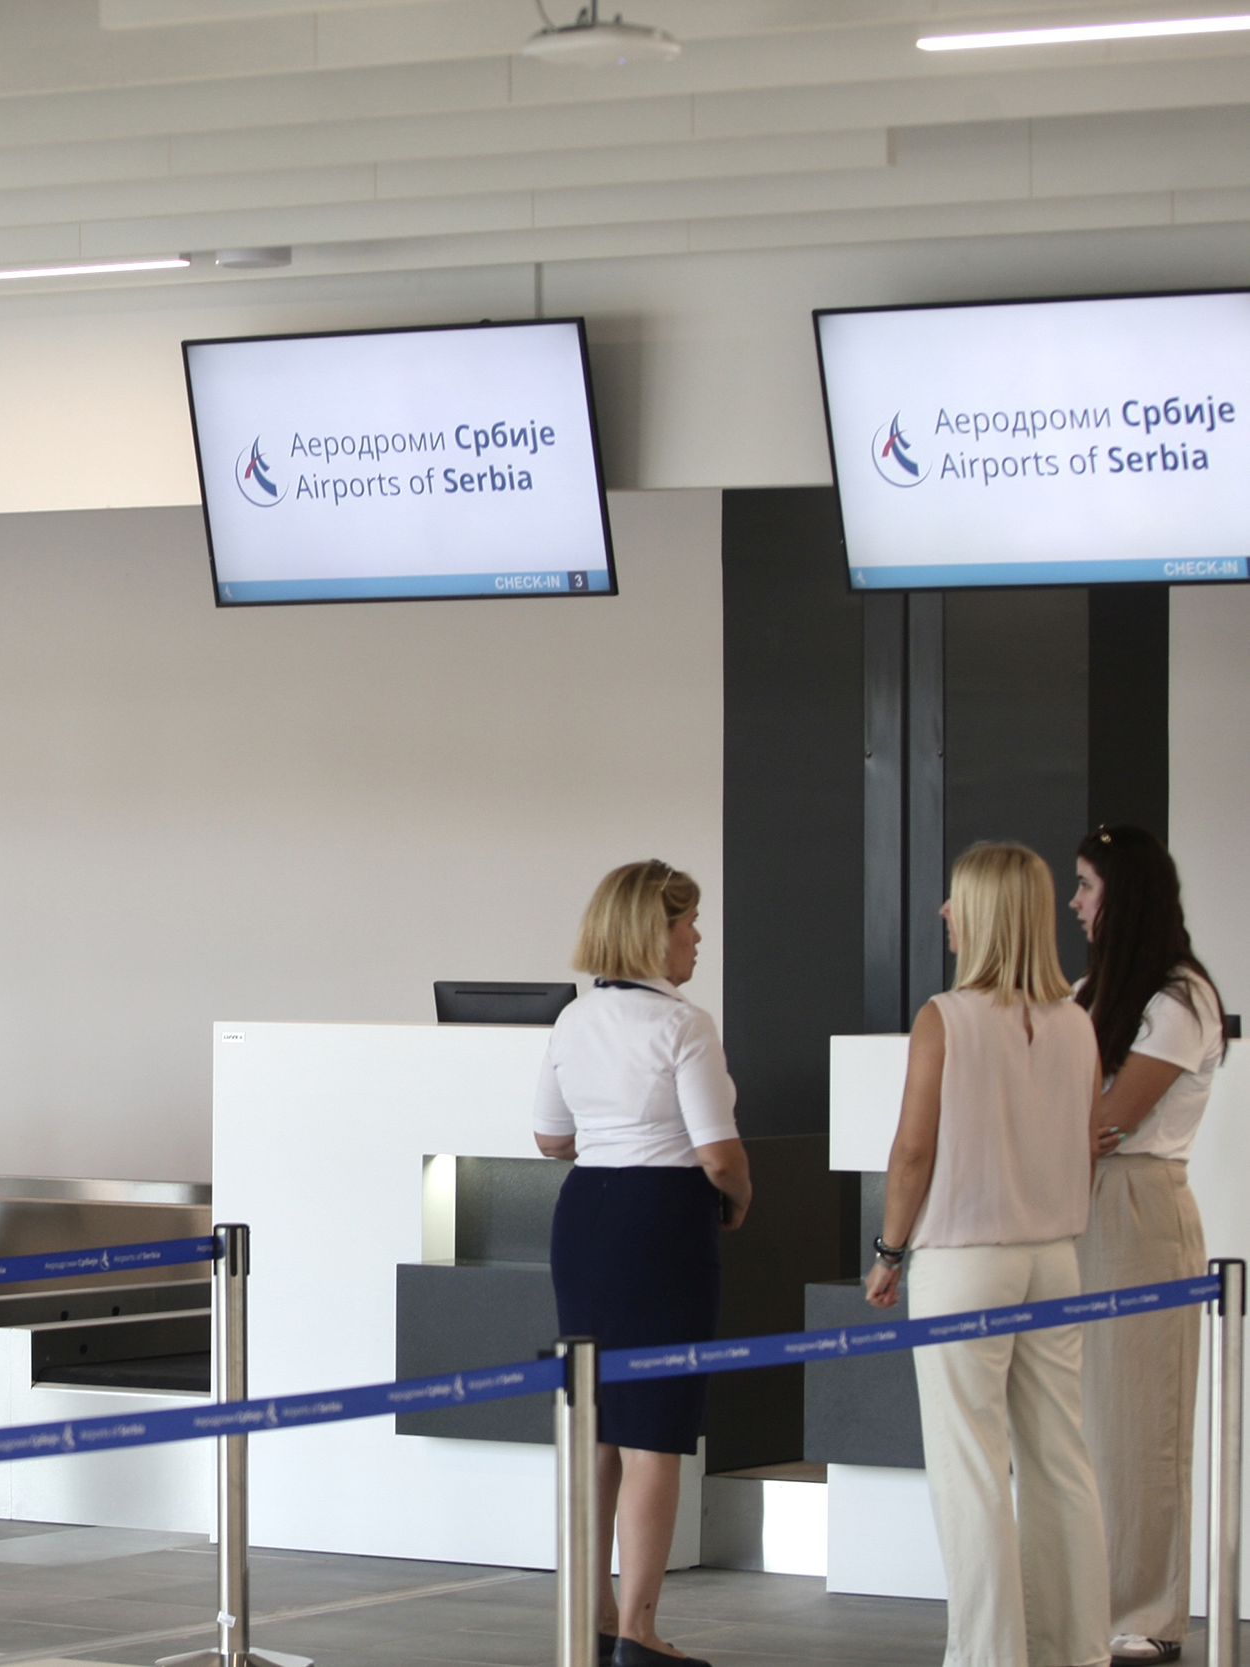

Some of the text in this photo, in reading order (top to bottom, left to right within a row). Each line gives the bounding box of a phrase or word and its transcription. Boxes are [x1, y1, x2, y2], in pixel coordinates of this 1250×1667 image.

[934, 394, 1236, 441] Аеродроми Србије
[290, 419, 556, 464] Аеродроми Србије
[296, 464, 533, 507] Airports of Serbia
[940, 442, 1210, 486] Airports of Serbia
[494, 573, 583, 589] CHECK-IN 3
[1163, 560, 1239, 577] CHECK-IN
